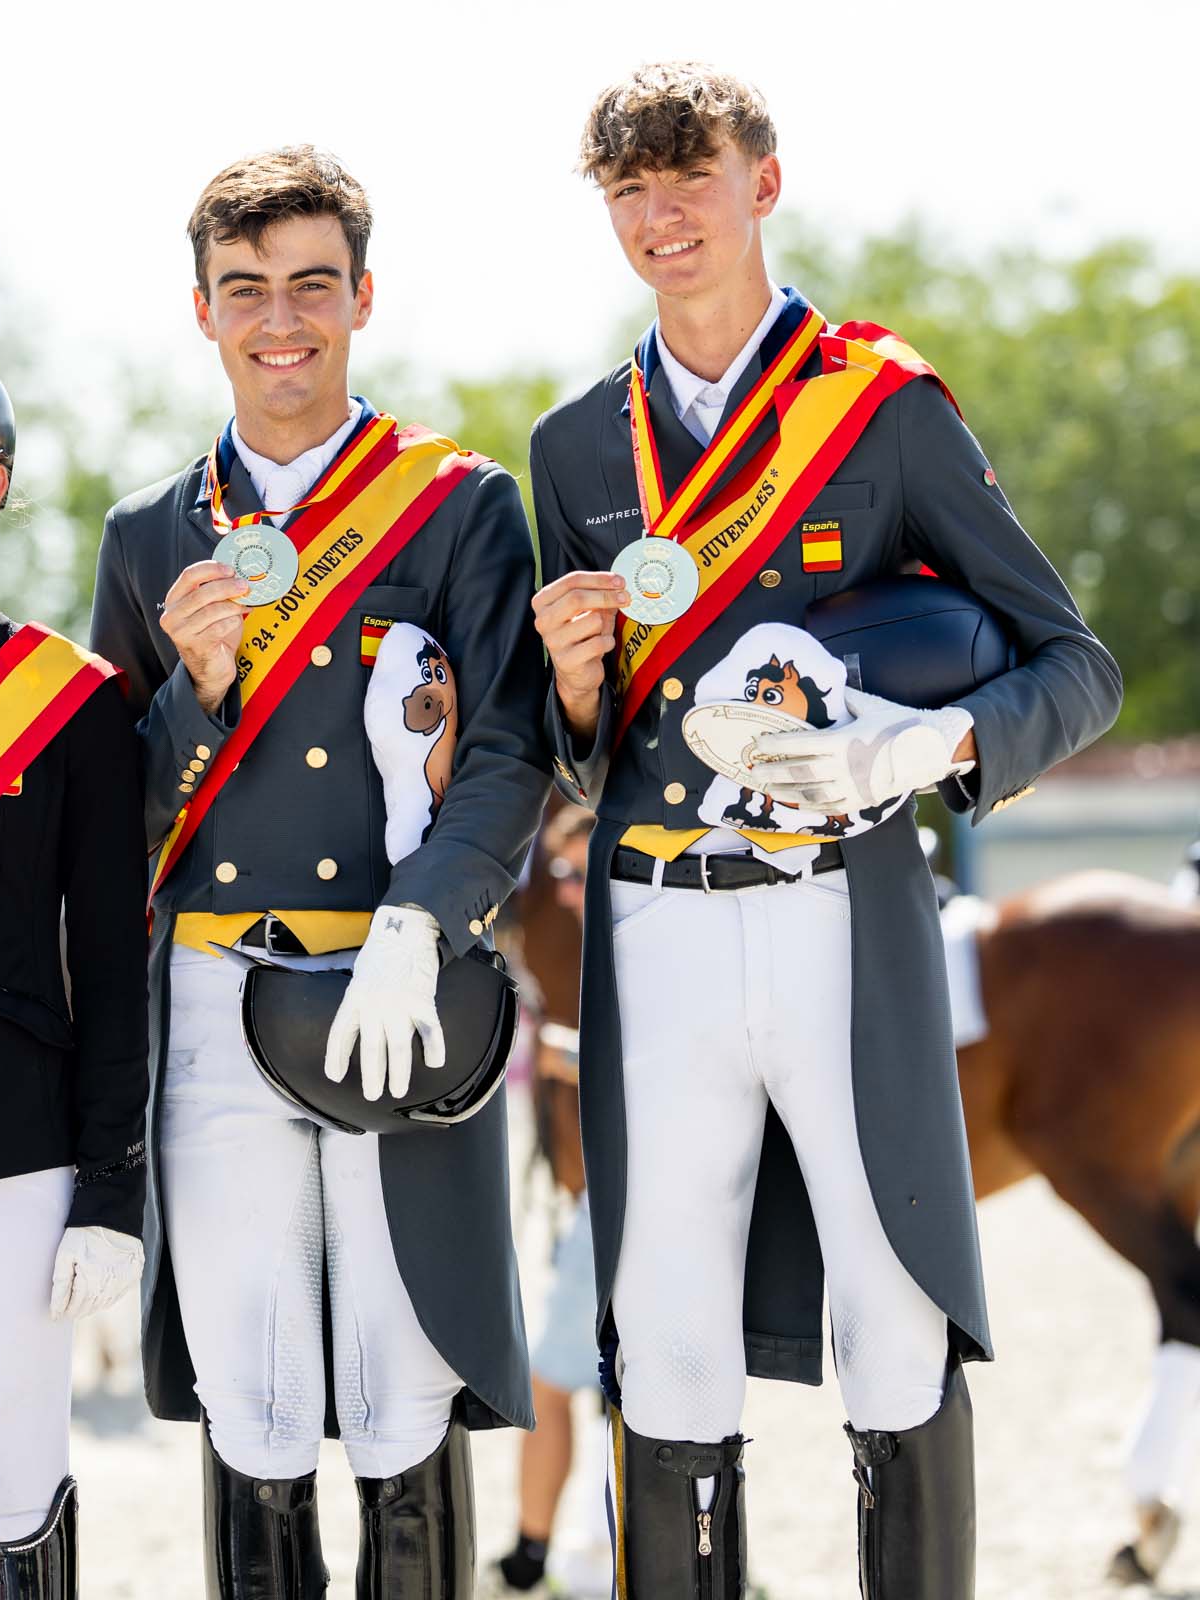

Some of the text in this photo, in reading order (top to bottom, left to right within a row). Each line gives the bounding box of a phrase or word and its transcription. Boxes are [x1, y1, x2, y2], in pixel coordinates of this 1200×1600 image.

[585, 508, 642, 526] MANFRED
[698, 479, 776, 568] JUVENILES
[802, 520, 839, 533] España
[274, 584, 310, 622] JOV.
[302, 527, 364, 588] JINETES
[363, 616, 393, 627] Españ
